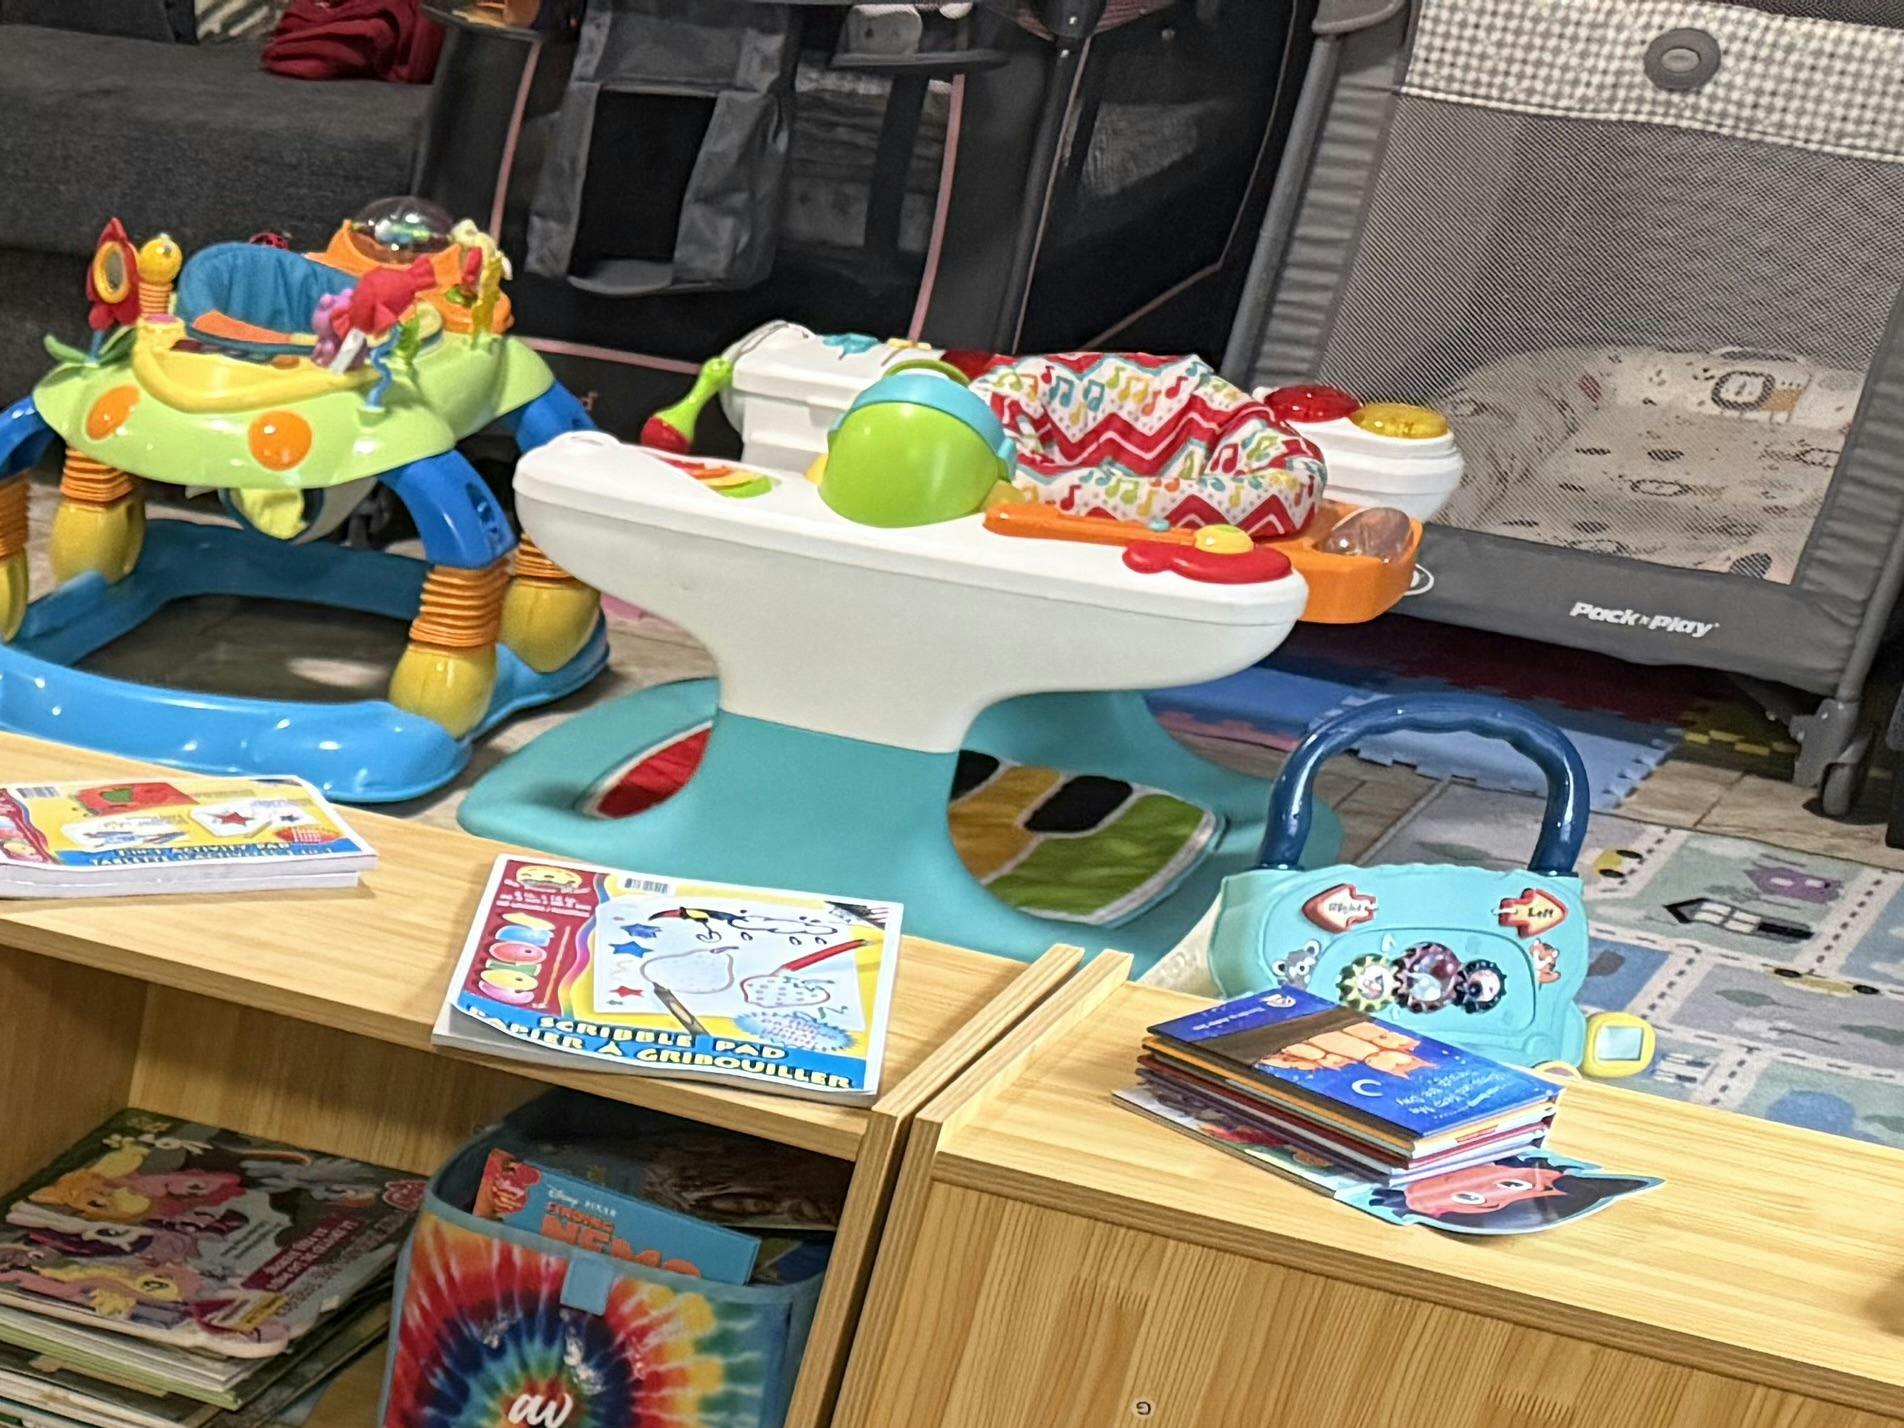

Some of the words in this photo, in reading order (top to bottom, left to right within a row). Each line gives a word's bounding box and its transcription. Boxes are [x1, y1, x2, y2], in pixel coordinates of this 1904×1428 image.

[1648, 614, 1713, 638] Play
[539, 1016, 693, 1049] SCRIBBLE
[715, 1037, 790, 1060] PAD
[635, 1047, 854, 1091] GRIBOUILLER
